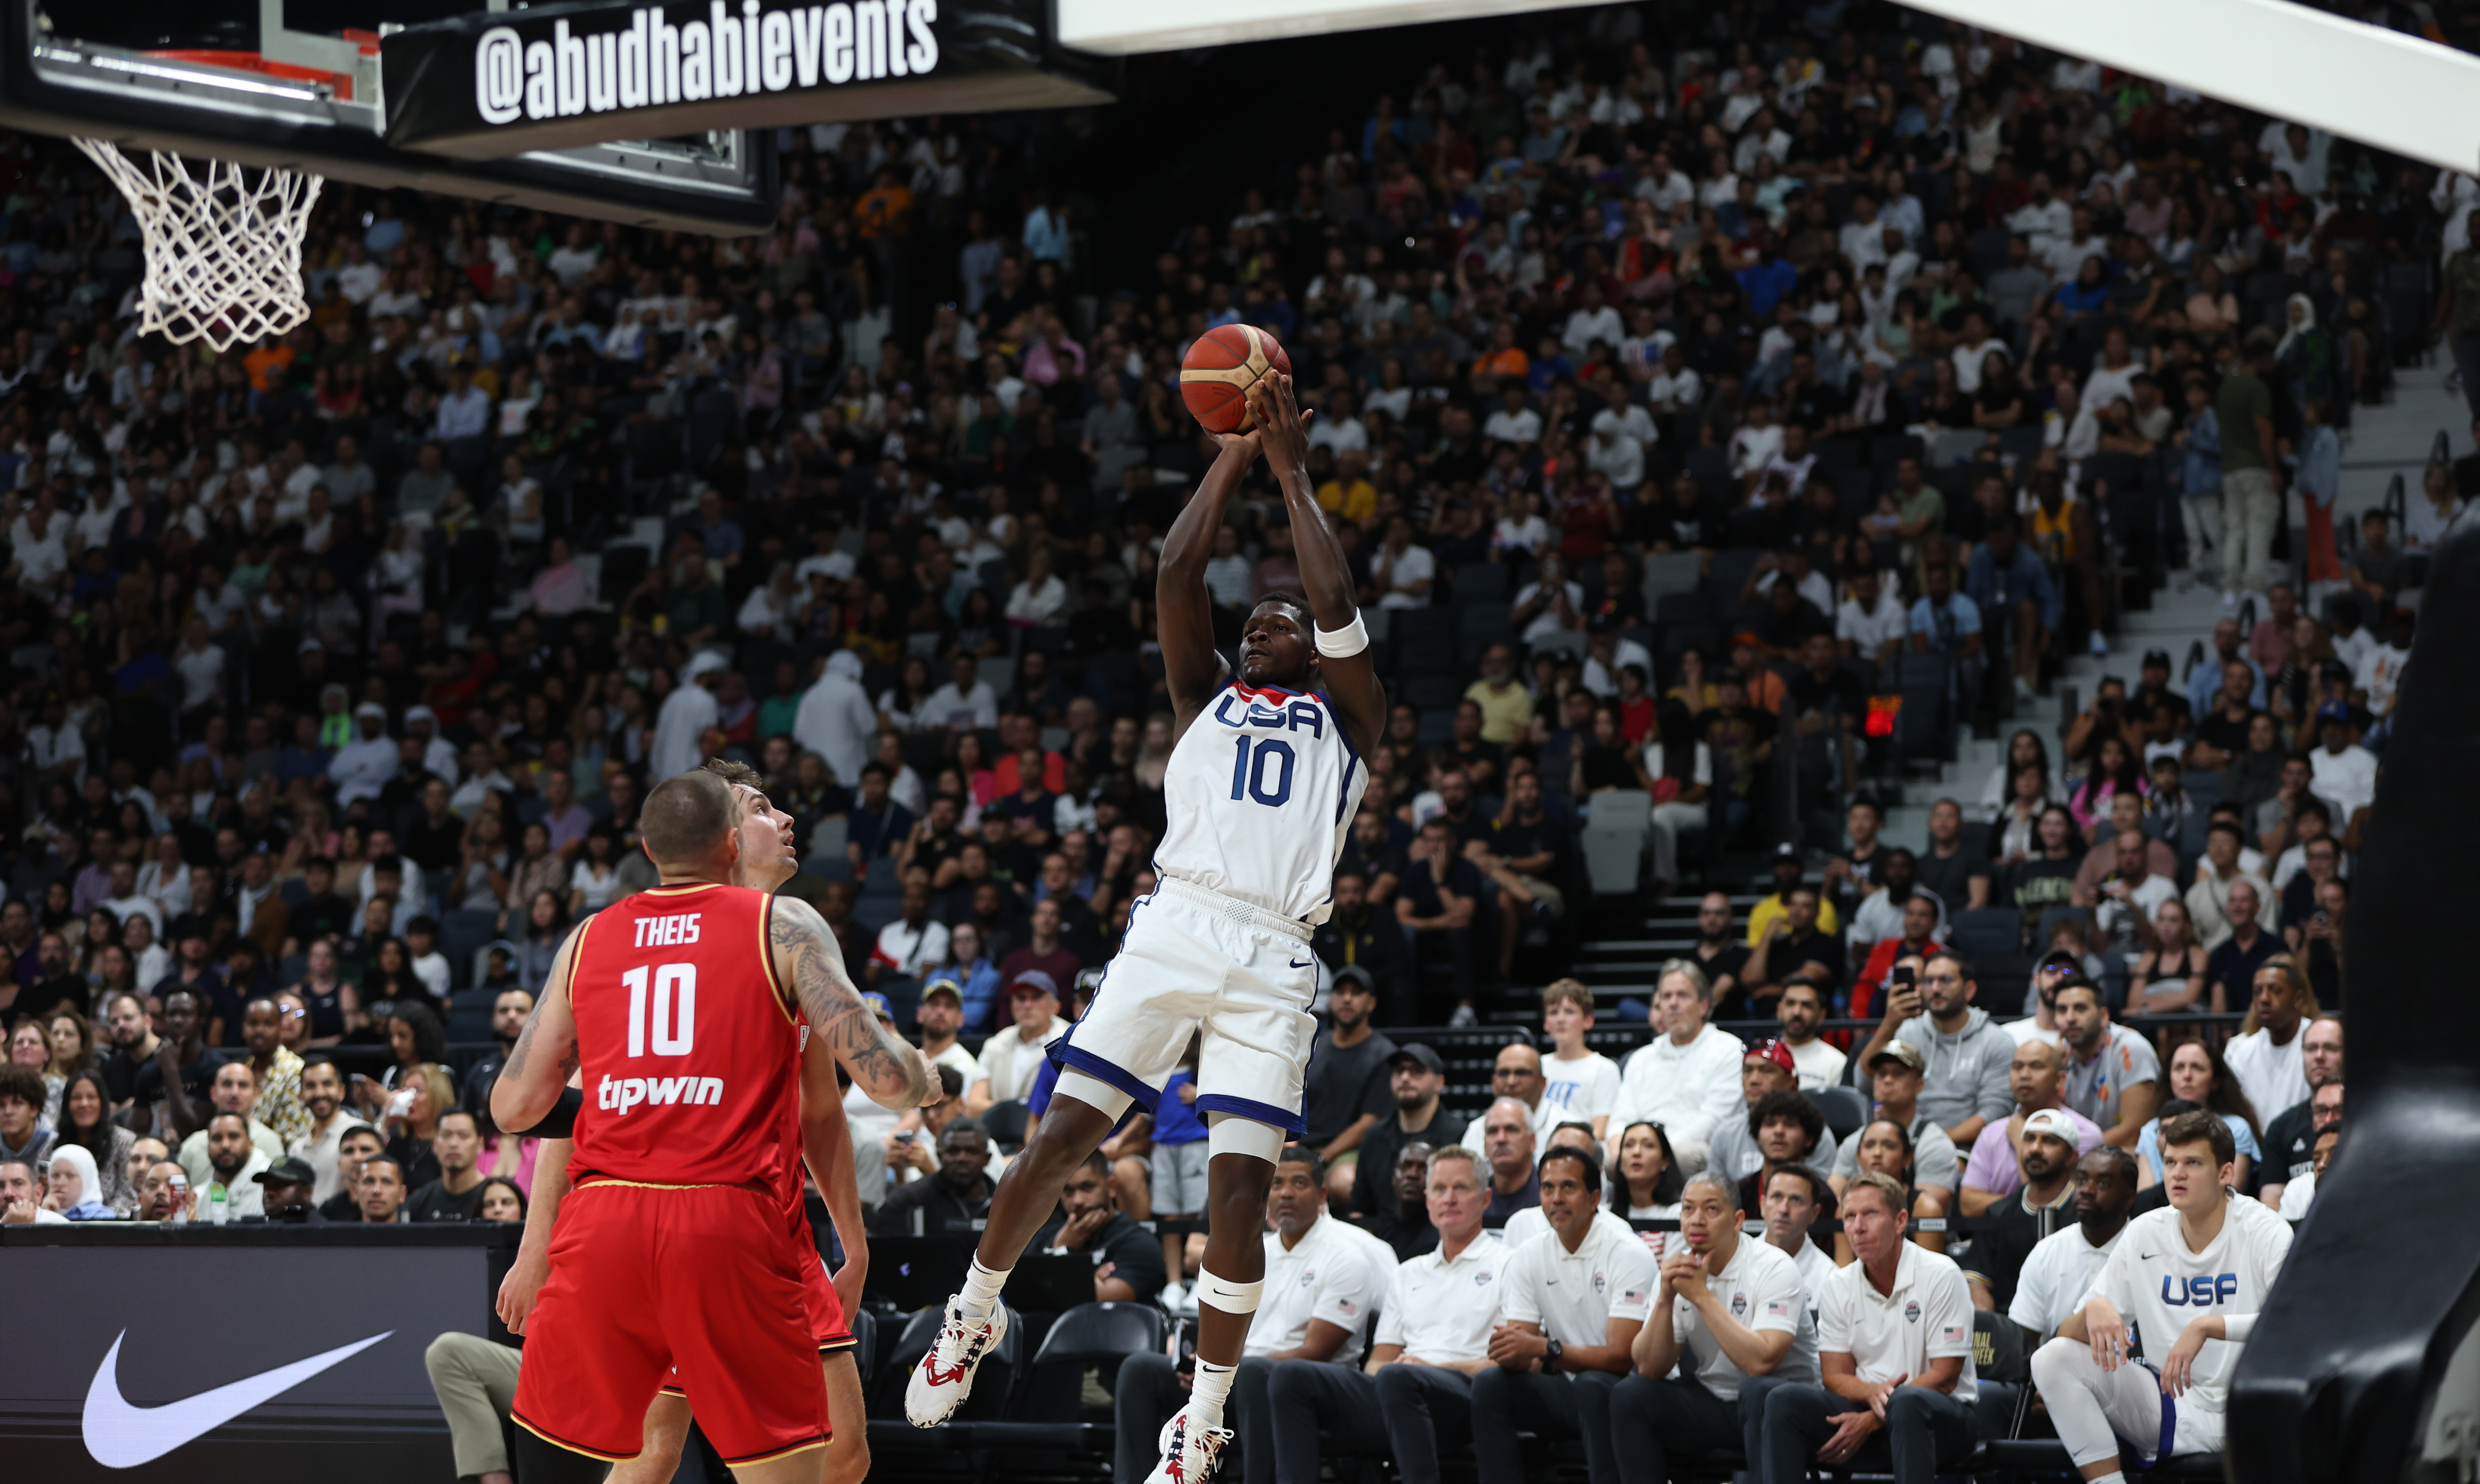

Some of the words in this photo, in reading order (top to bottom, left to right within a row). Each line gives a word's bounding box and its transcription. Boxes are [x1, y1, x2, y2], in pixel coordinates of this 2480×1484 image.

[476, 0, 939, 124] @abudhabievents
[1214, 693, 1323, 740] USA
[1230, 734, 1296, 808] 10
[634, 912, 702, 948] THEIS
[622, 961, 697, 1058] 10
[598, 1073, 724, 1116] tipwin
[2161, 1273, 2237, 1306] USA
